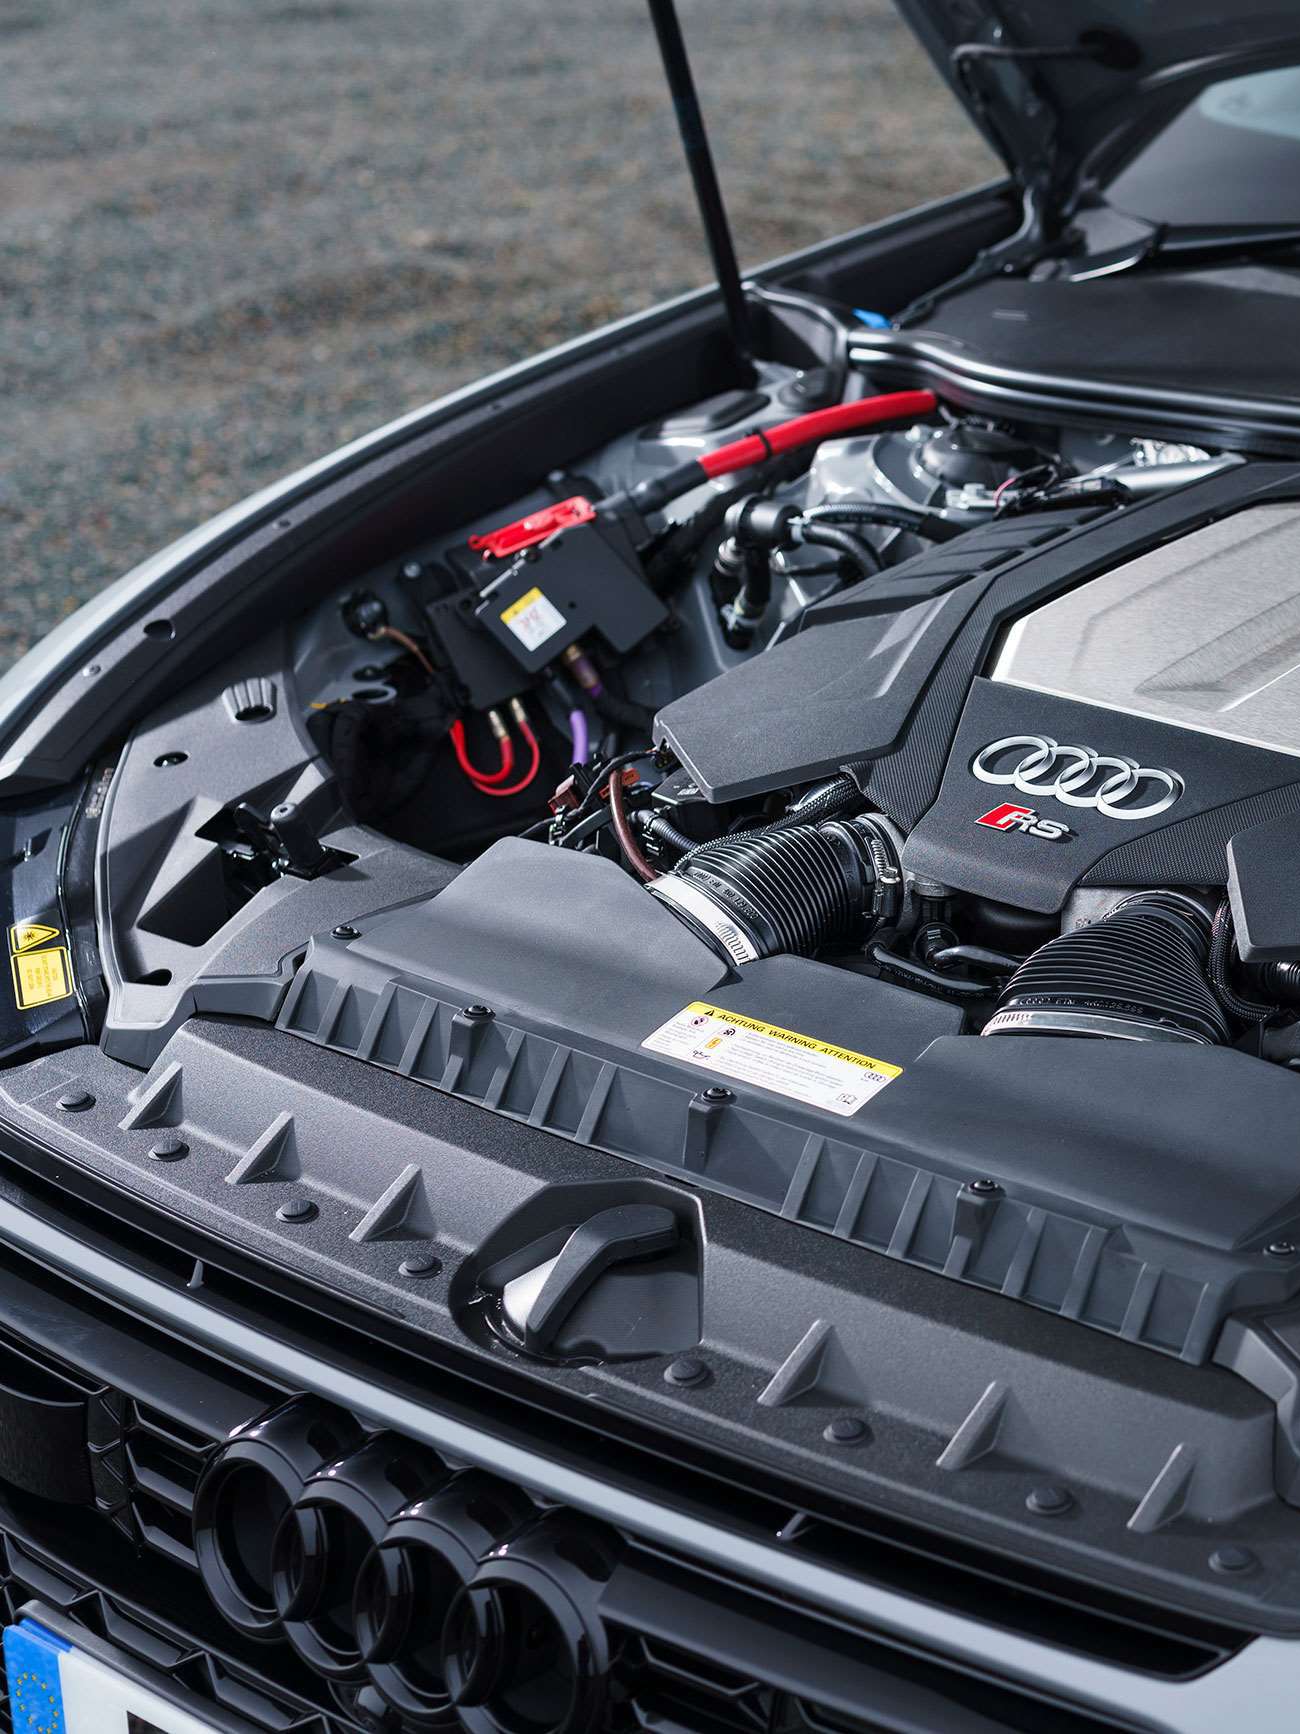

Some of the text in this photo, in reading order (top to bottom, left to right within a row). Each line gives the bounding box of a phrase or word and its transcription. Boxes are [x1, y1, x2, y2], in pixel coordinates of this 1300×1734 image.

[994, 810, 1070, 840] RS
[718, 1013, 765, 1033] ACHTUNG
[768, 1030, 818, 1050] WARNING
[820, 1047, 877, 1070] ATTENTION
